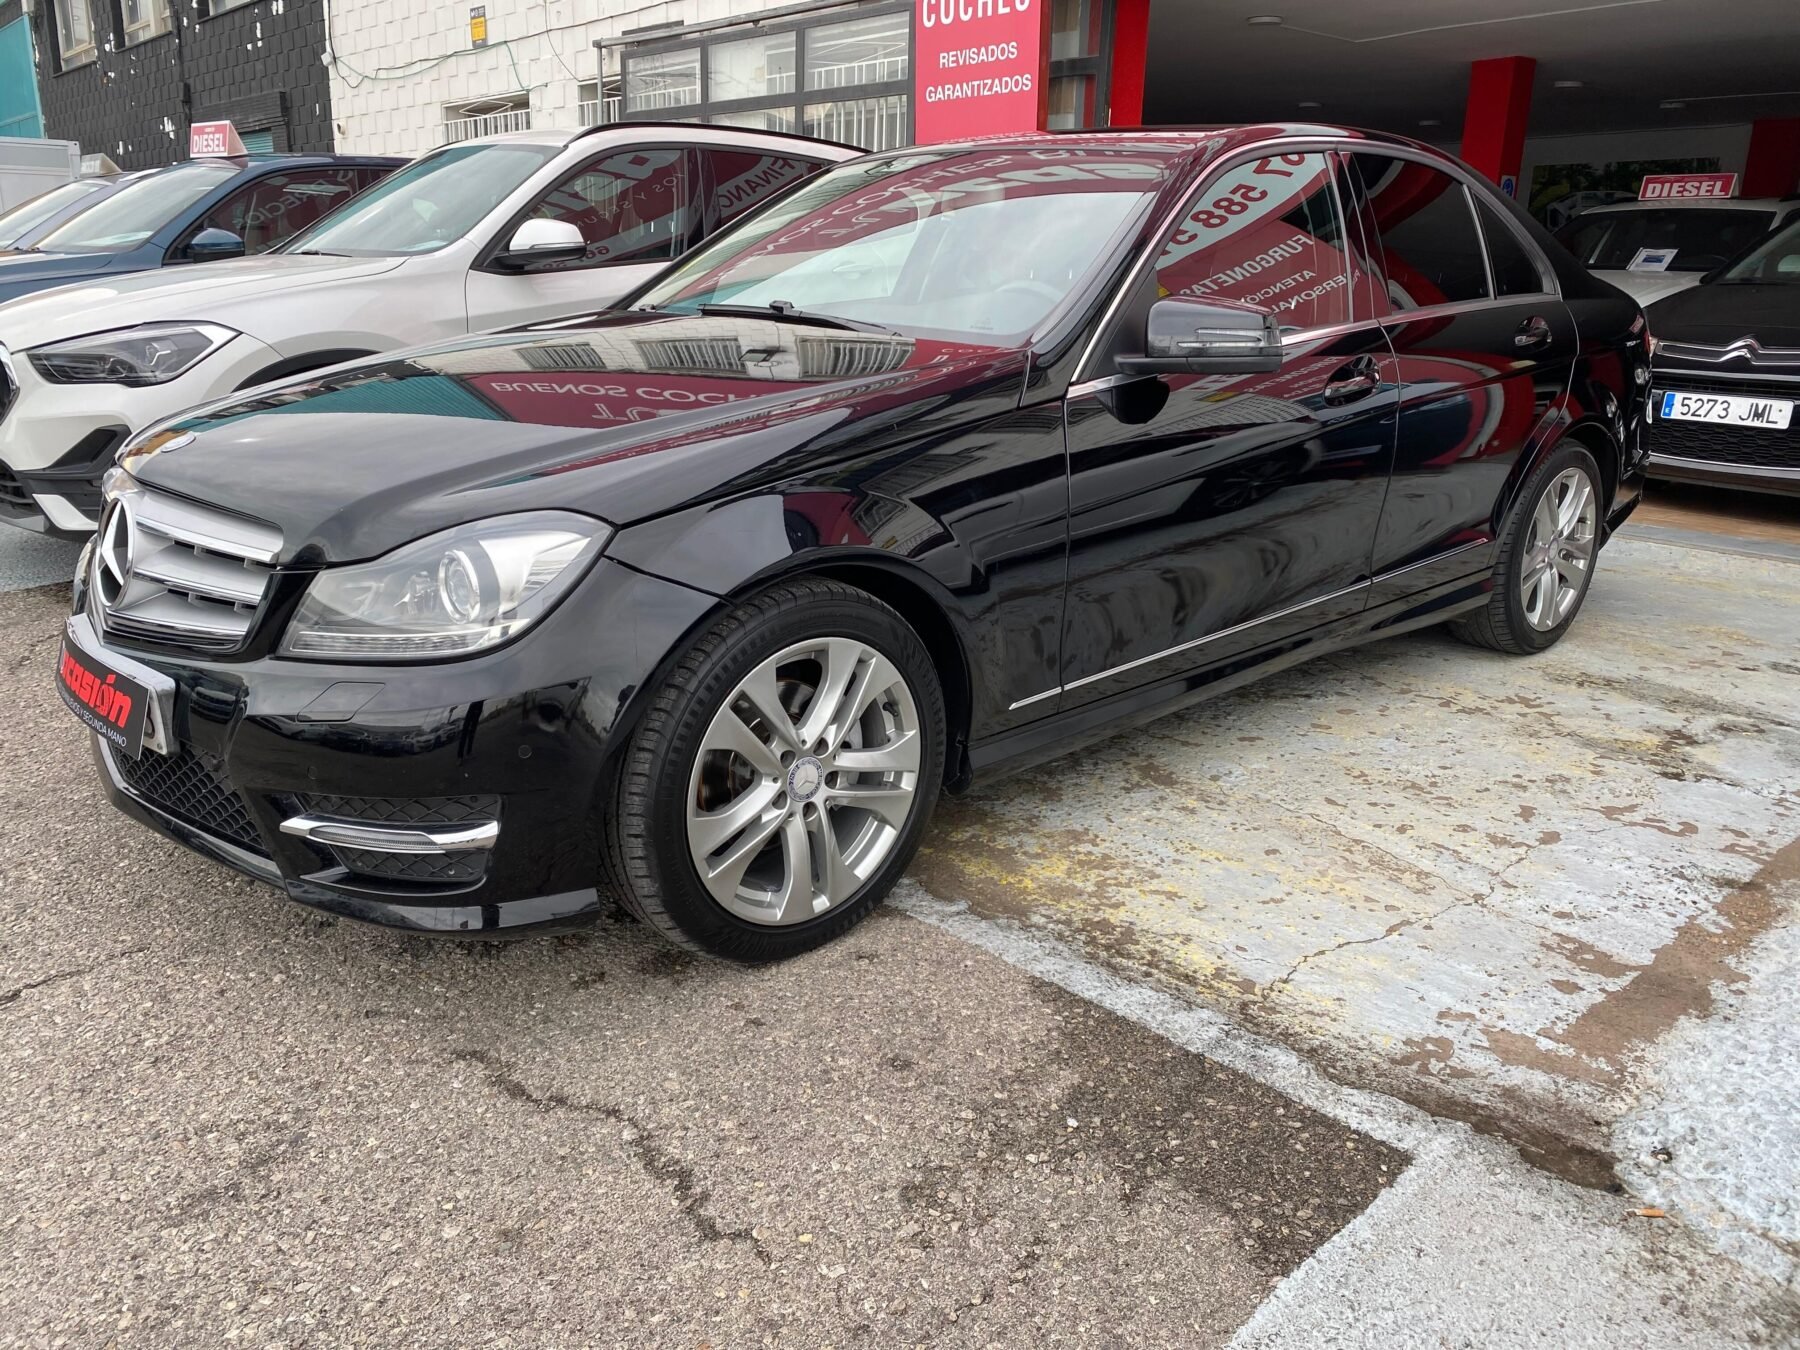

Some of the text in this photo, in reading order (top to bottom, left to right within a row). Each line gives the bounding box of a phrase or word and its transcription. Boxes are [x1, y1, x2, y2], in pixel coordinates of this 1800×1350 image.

[939, 41, 1018, 69] REVISADOS
[925, 73, 1032, 103] GARANTIZADOS
[193, 134, 225, 153] DIESEL
[1645, 181, 1726, 198] DIESEL
[1680, 396, 1731, 419] 5273
[1738, 402, 1778, 425] JML
[107, 727, 127, 748] MANO
